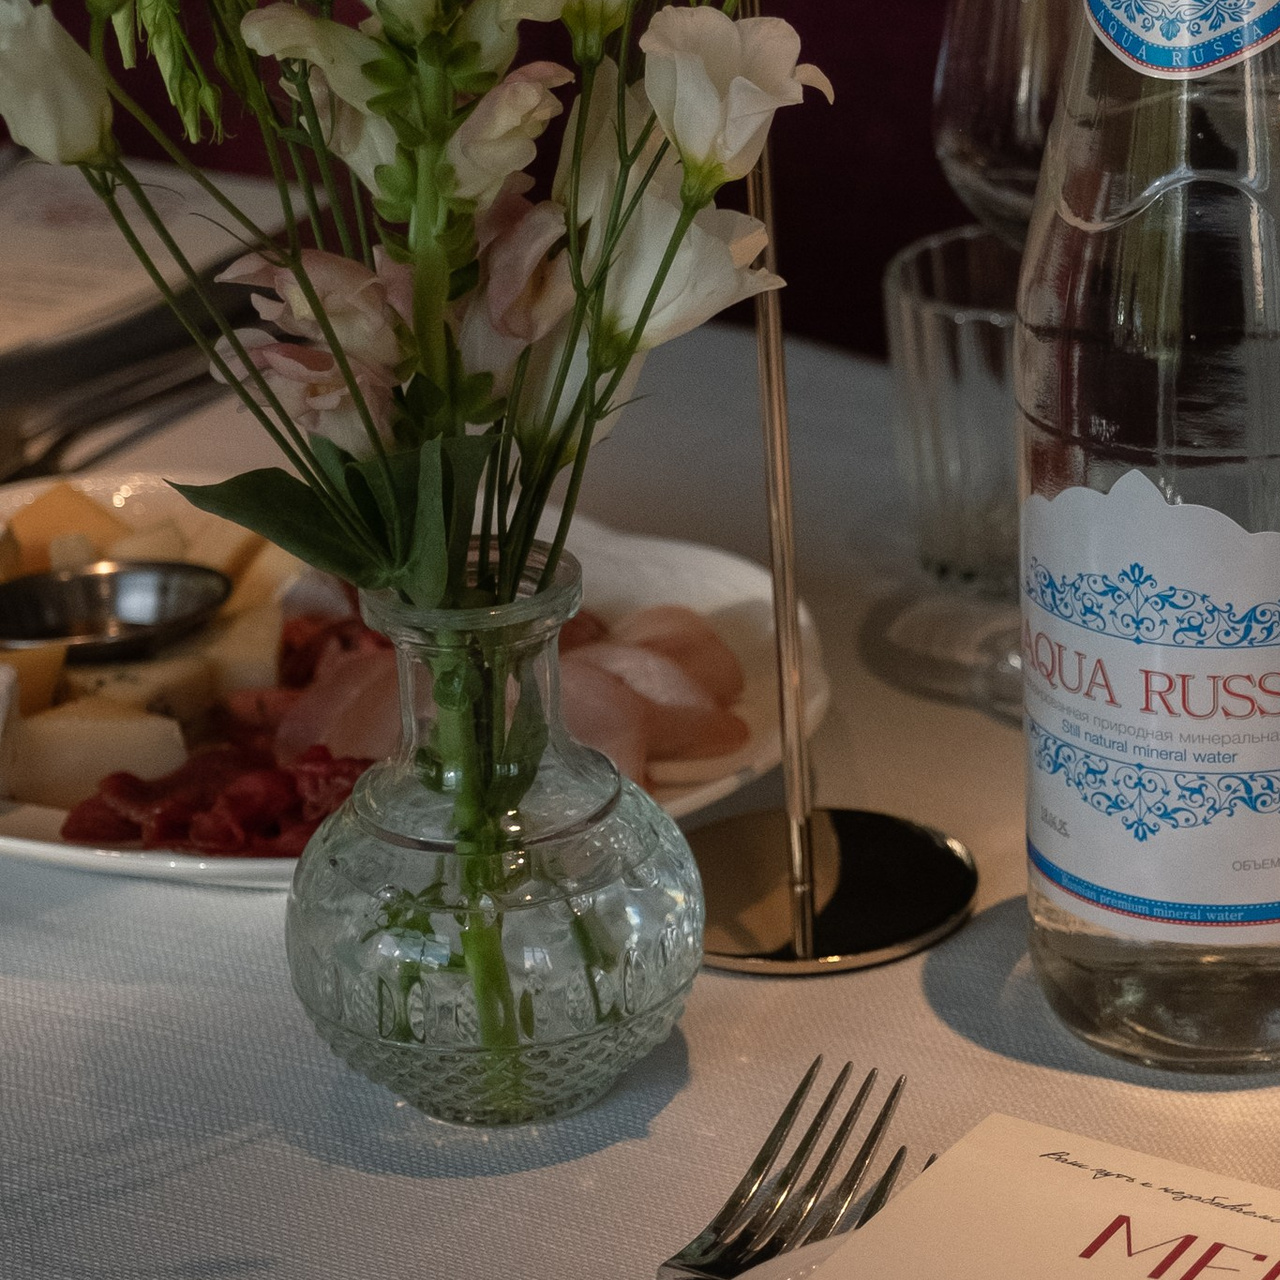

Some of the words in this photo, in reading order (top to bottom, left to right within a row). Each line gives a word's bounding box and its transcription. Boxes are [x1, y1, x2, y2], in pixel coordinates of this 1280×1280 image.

[1097, 10, 1147, 60] AQUA
[1171, 25, 1264, 66] RUSSA
[1021, 618, 1122, 708] AQUA
[1062, 719, 1081, 738] Still
[1084, 730, 1127, 753] natural
[1133, 745, 1187, 762] mineral
[1193, 750, 1238, 763] water
[1093, 715, 1173, 742] природная
[1232, 857, 1280, 871] ОБЪЕМ
[1100, 893, 1150, 915] premium
[1153, 905, 1201, 920] mineral
[1206, 910, 1244, 921] water
